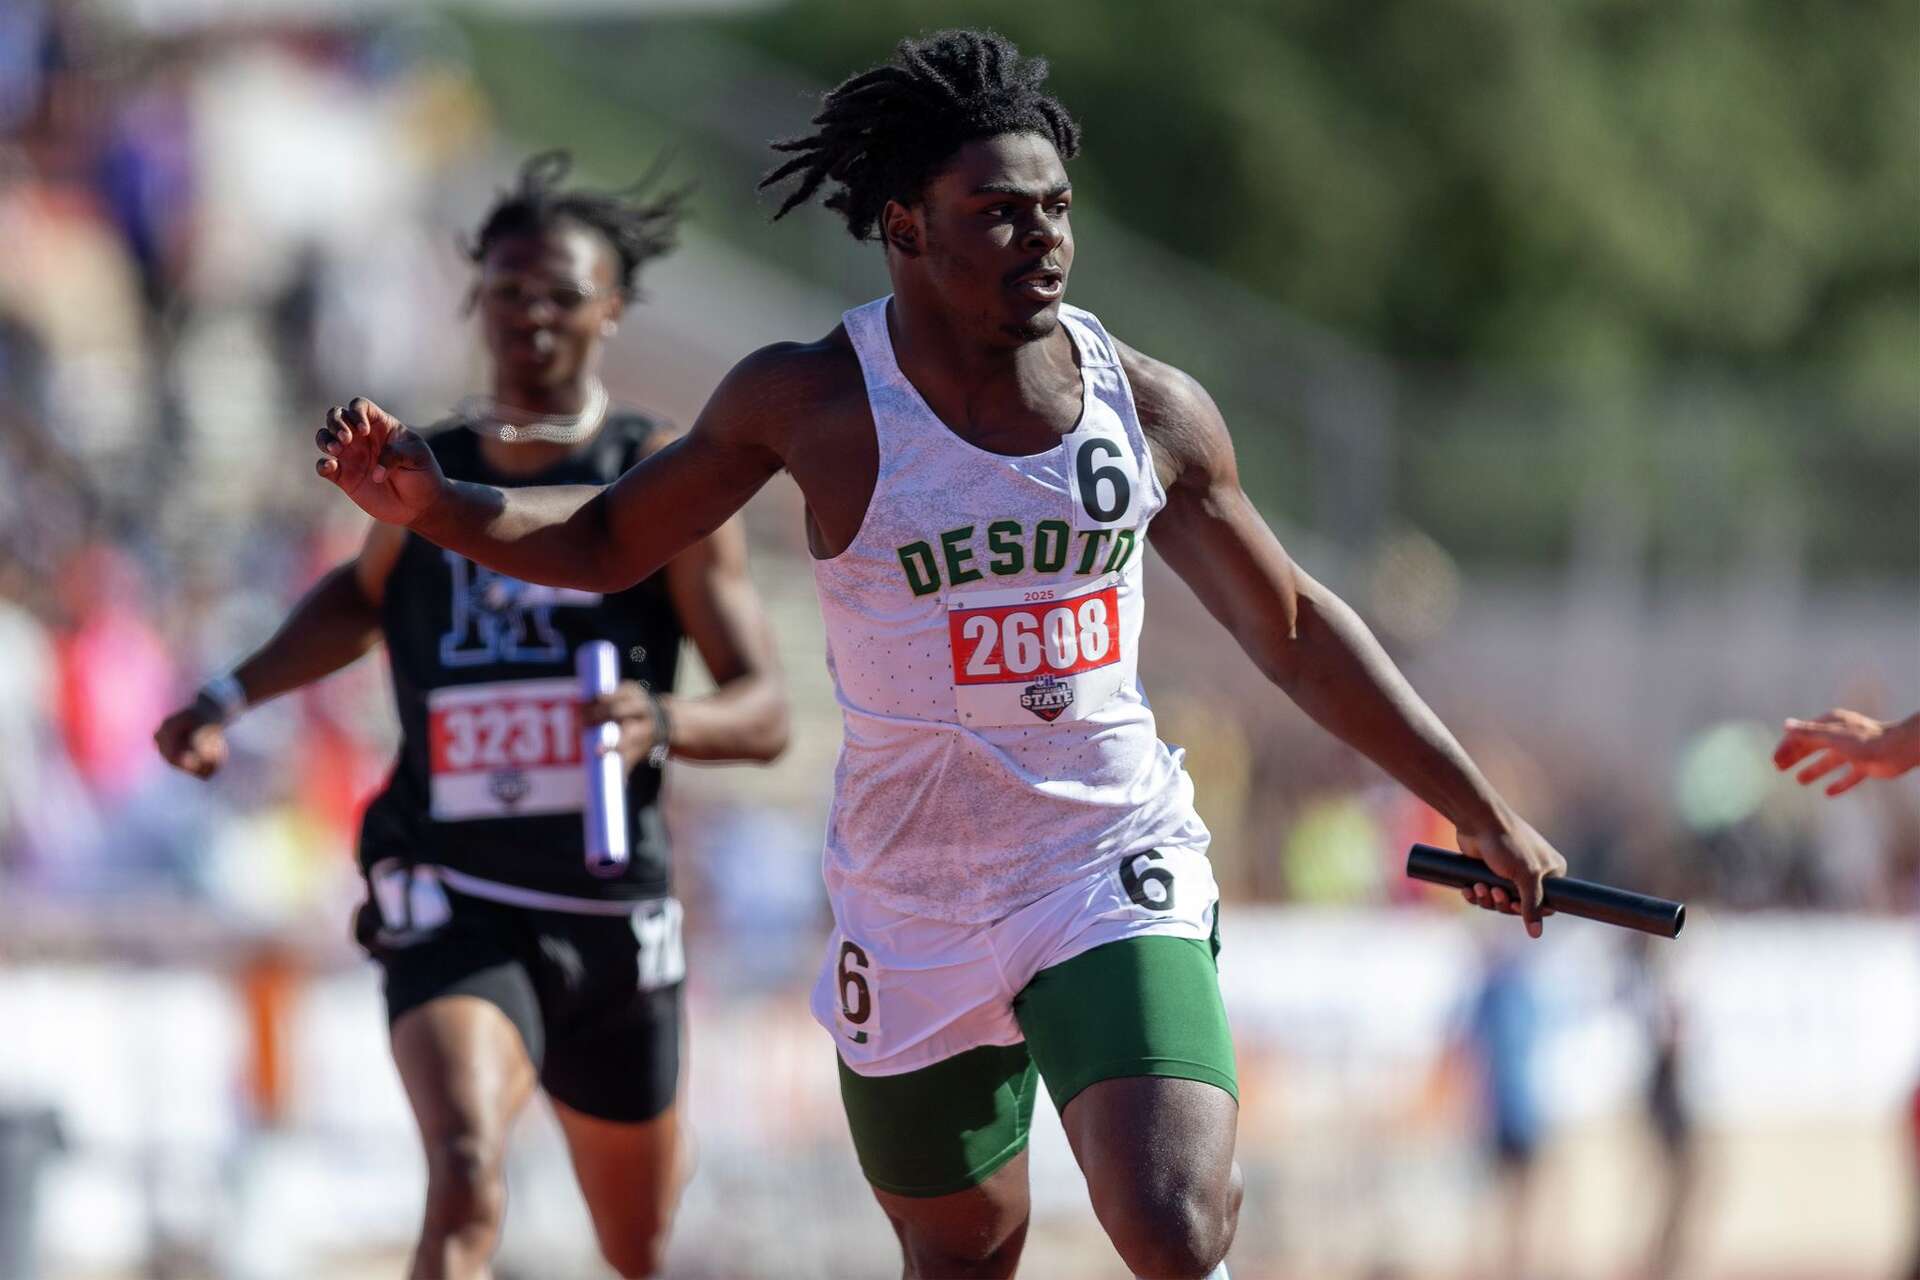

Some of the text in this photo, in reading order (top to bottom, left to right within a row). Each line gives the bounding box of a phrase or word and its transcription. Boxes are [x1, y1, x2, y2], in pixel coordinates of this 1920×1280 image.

[1075, 437, 1130, 523] 6
[898, 519, 1136, 597] DESOTO
[1023, 590, 1055, 602] 2025
[962, 598, 1110, 676] 2608
[1021, 690, 1073, 706] STATE
[444, 704, 572, 768] 3231
[1118, 848, 1175, 911] 6
[838, 940, 871, 1024] 6
